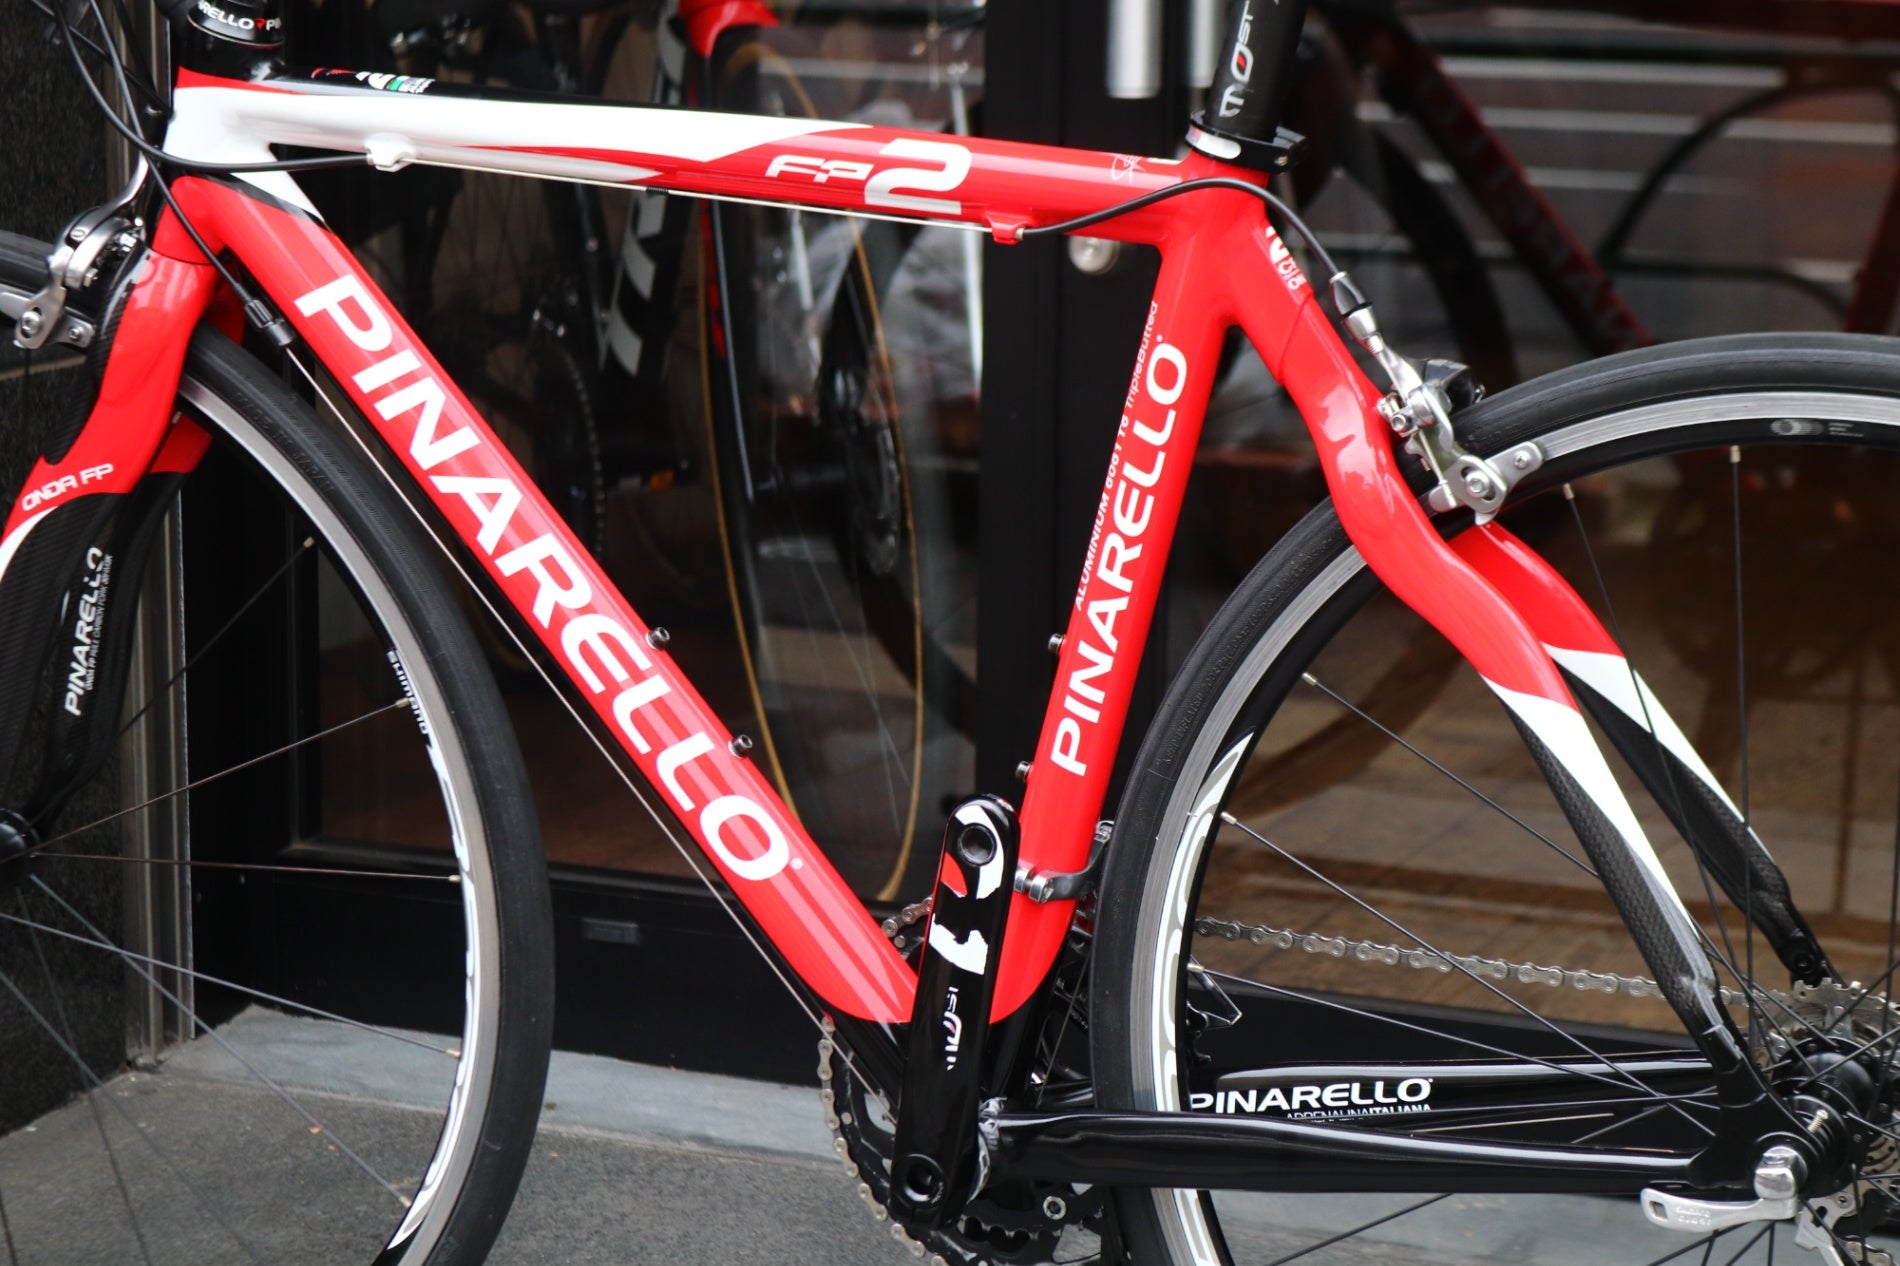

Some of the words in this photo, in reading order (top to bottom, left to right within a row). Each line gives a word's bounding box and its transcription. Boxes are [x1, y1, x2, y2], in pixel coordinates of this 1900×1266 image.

[22, 475, 77, 511] ONDA
[80, 463, 114, 485] FP
[1051, 343, 1187, 777] PINARELLO
[1076, 491, 1110, 611] ALUMINIUM
[1105, 441, 1122, 489] 6061
[1117, 414, 1130, 438] T6
[1125, 301, 1159, 408] TripleButted
[64, 547, 103, 716] PINARELLO
[294, 274, 794, 881] PINARELLO
[1190, 1078, 1431, 1114] PINARELLO
